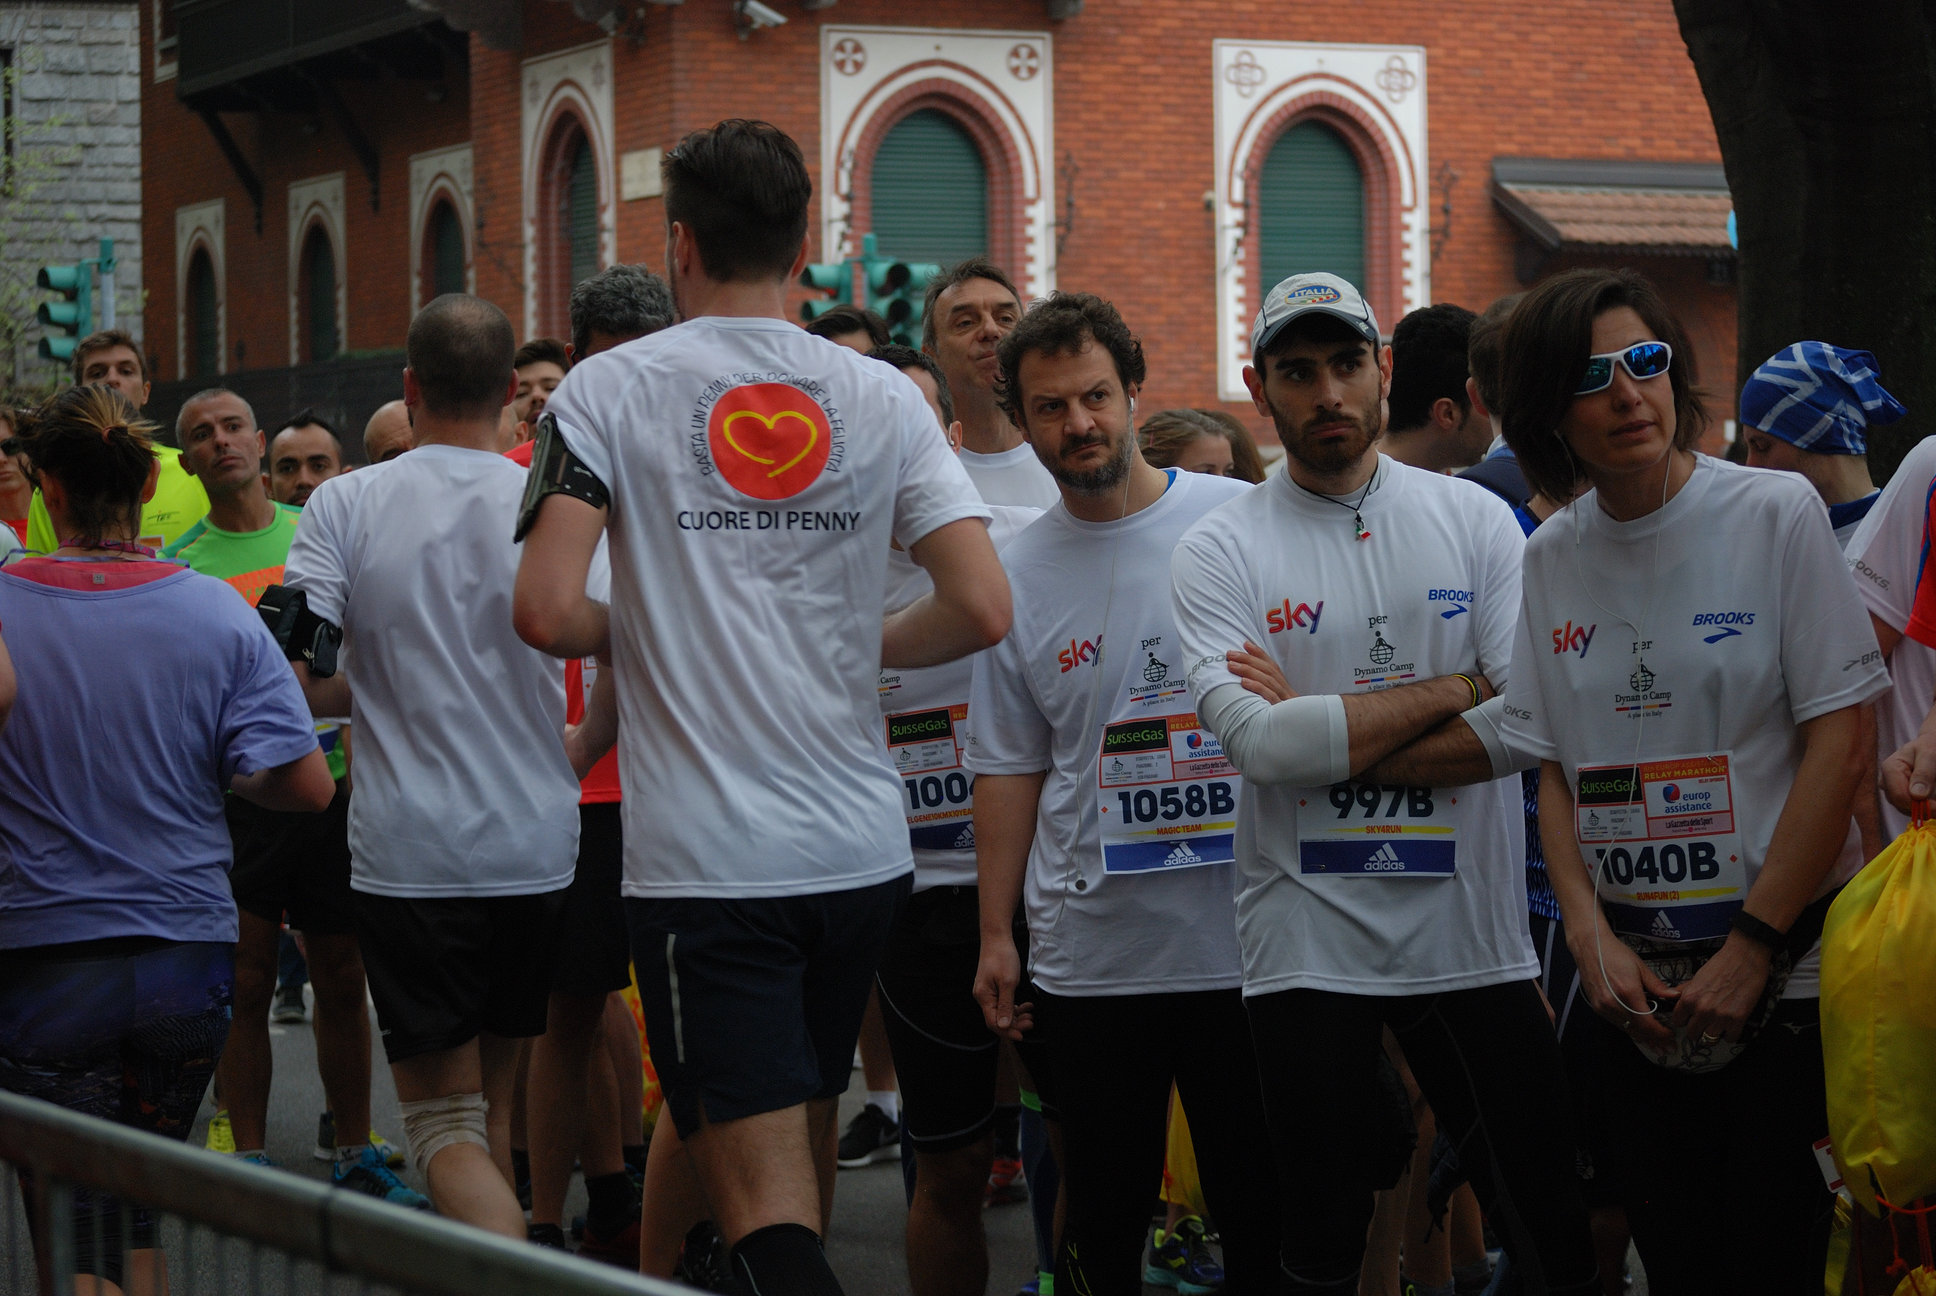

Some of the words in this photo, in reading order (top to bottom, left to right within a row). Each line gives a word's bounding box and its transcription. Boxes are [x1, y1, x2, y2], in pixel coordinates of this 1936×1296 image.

[1294, 287, 1335, 297] ITALIA
[733, 372, 764, 384] PER
[697, 373, 733, 409] PENNY
[766, 371, 827, 402] DONARE
[822, 398, 838, 418] LA
[691, 409, 708, 430] UN
[691, 432, 715, 477] BASTA
[677, 510, 751, 531] CUORE
[757, 511, 779, 530] DI
[786, 511, 861, 531] PENNY
[1427, 589, 1475, 603] BROOKS
[1266, 598, 1324, 635] sky
[1367, 615, 1388, 629] per
[1691, 611, 1756, 627] BROOKS
[1140, 636, 1162, 651] per
[1552, 620, 1597, 659] sky
[1058, 634, 1103, 674] sky
[1353, 666, 1388, 679] Dynamo
[1389, 662, 1415, 672] Camp
[880, 675, 901, 684] Camp
[1129, 683, 1162, 696] Dynamo
[1163, 679, 1186, 688] Camp
[1649, 691, 1672, 701] Camp
[892, 719, 948, 737] SuisseGas
[1170, 721, 1194, 731] RELAY
[1106, 729, 1165, 746] SuisseGas
[1644, 771, 1672, 780] RELAY
[1673, 766, 1725, 777] MARATHON
[905, 772, 975, 810] 100
[1682, 791, 1711, 802] europ
[1117, 781, 1235, 825] 1058B
[1329, 783, 1434, 819] 997B
[1664, 802, 1712, 814] assistance
[1156, 825, 1182, 836] MAGIC
[1182, 823, 1202, 834] TEAM
[1365, 825, 1402, 834] SKY4RUN
[1164, 854, 1202, 866] adidas
[1364, 860, 1406, 871] adidas
[1595, 841, 1720, 886] 1040B
[1636, 891, 1669, 901] RUN4FUN
[1670, 890, 1680, 901] (2)
[1651, 928, 1681, 939] adidas
